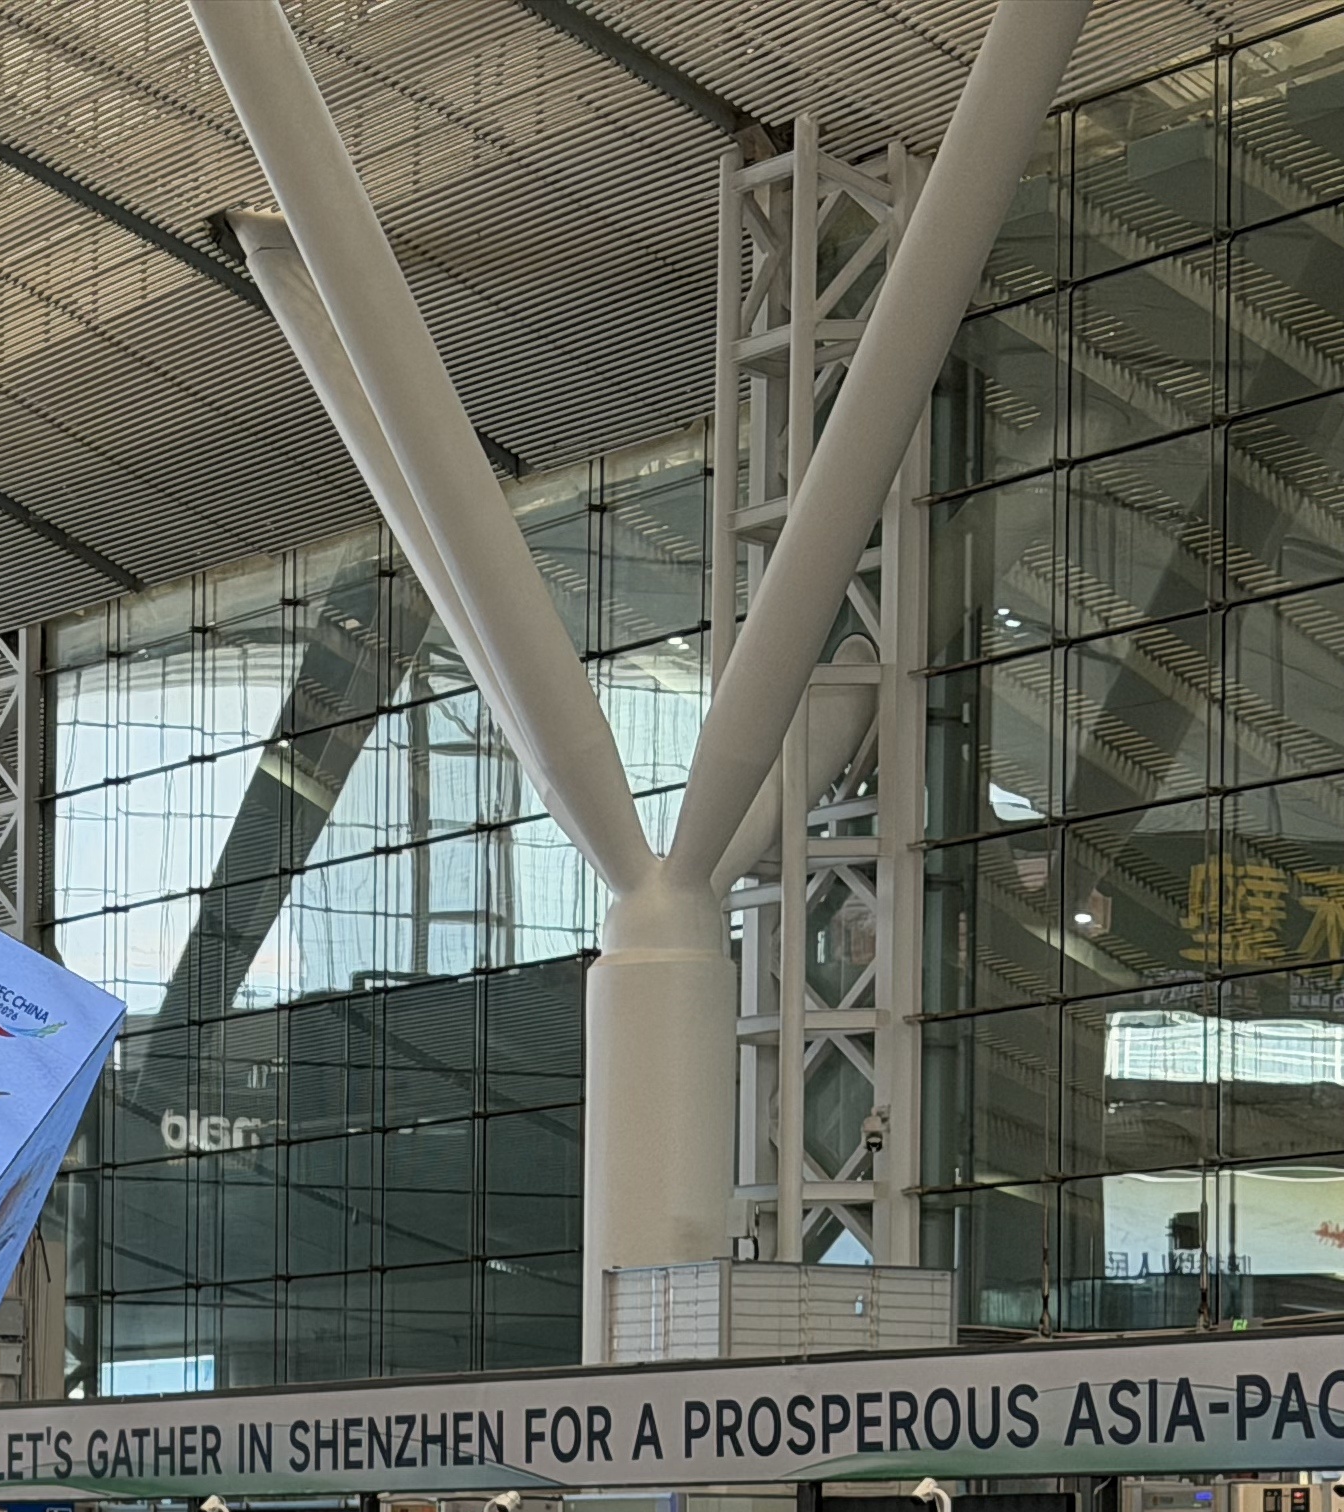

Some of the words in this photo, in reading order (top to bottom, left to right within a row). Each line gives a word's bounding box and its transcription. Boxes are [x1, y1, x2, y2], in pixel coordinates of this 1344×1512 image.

[11, 994, 50, 1025] CHINA
[86, 1424, 223, 1480] GATHER
[238, 1421, 274, 1475] IN
[288, 1410, 505, 1473] SHENZHEN
[524, 1404, 613, 1465] FOR
[631, 1401, 666, 1462] A
[683, 1382, 1042, 1459] PROSPEROUS
